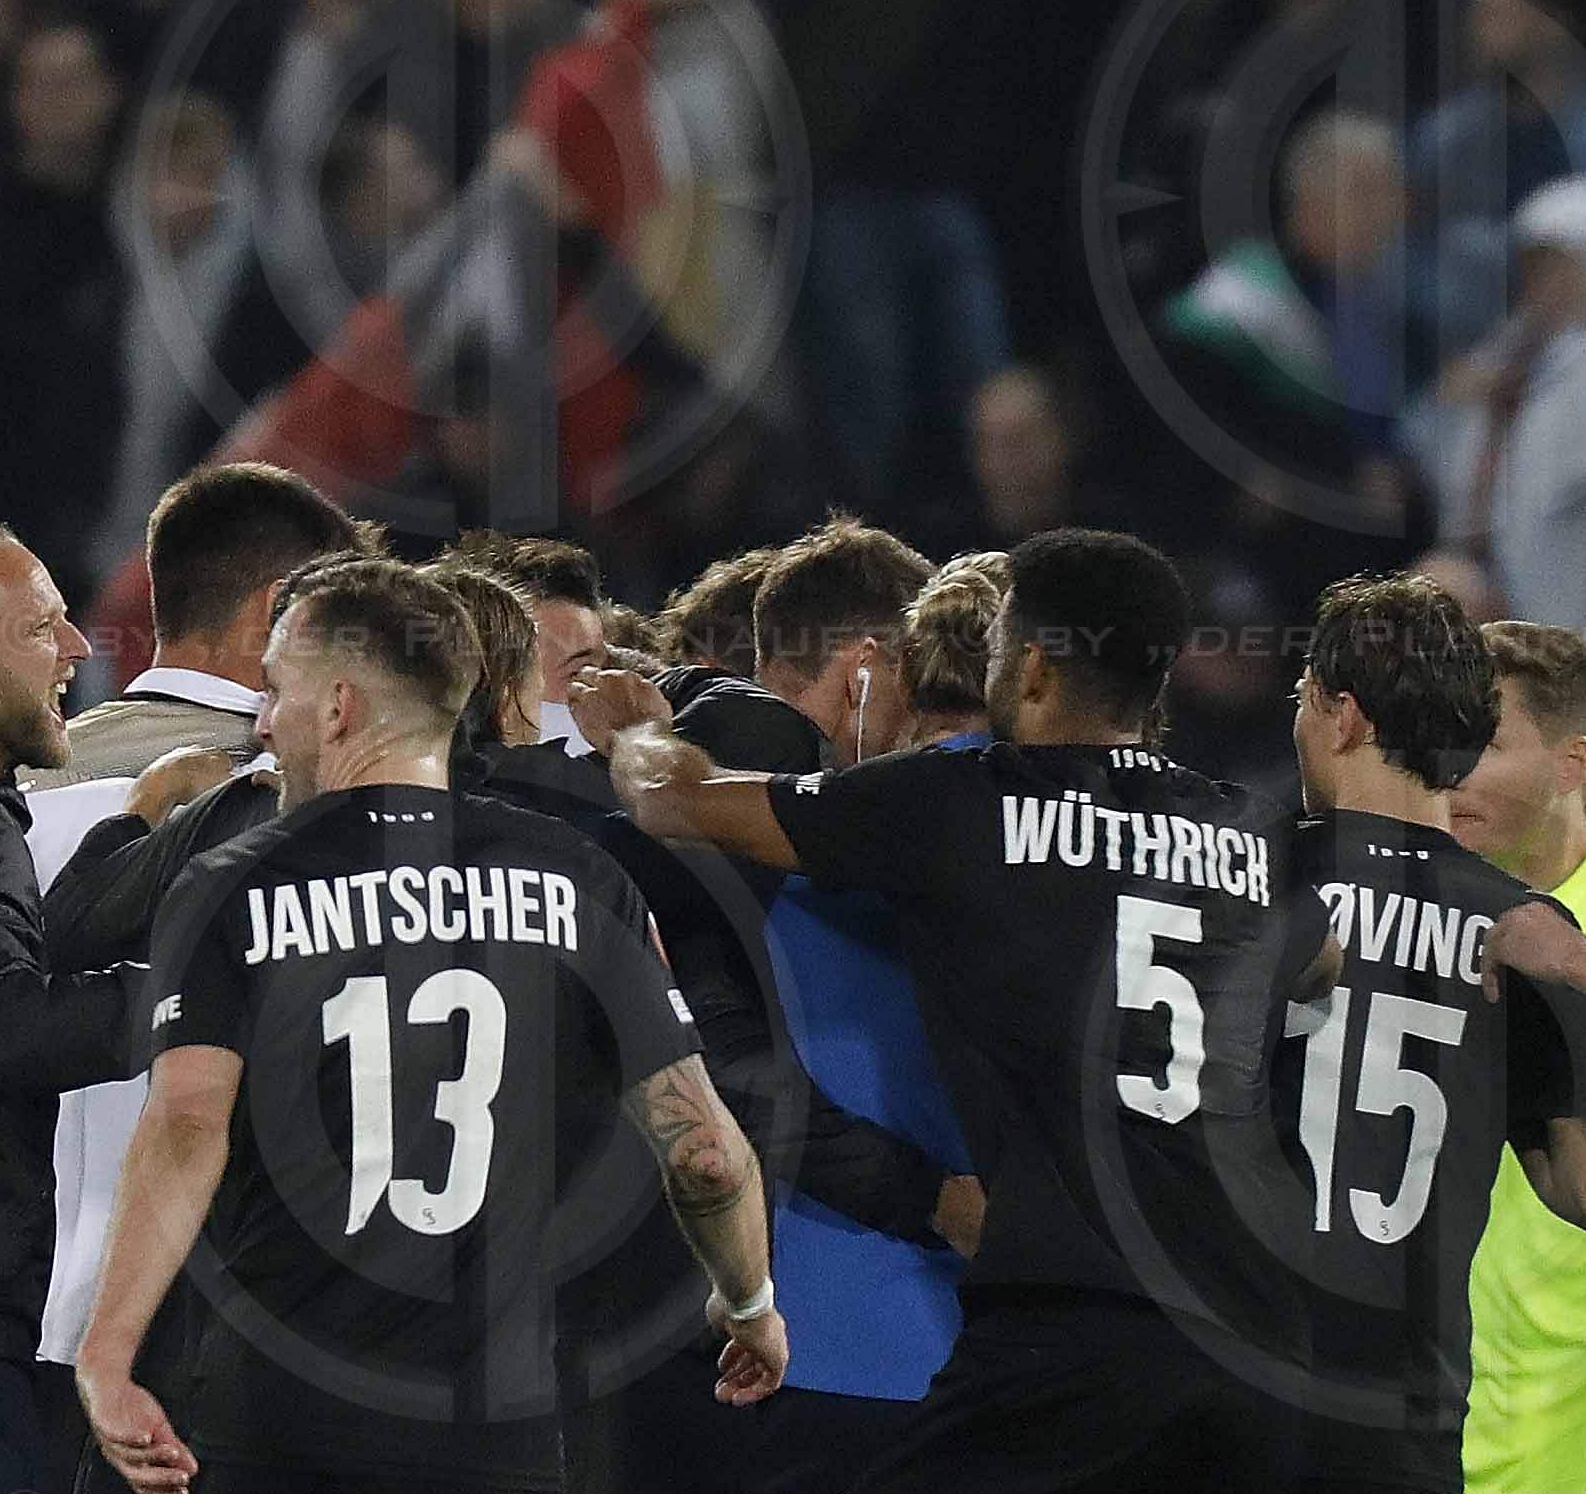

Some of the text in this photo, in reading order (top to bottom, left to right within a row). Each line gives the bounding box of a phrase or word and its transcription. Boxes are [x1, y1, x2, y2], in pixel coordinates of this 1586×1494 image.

[244, 864, 578, 965] JANTSCHER
[1001, 788, 1270, 907] WÜTHRICH
[1314, 881, 1495, 986] ØVING
[1115, 894, 1206, 1125] 5
[320, 968, 506, 1236] 13
[1284, 986, 1467, 1245] 15
